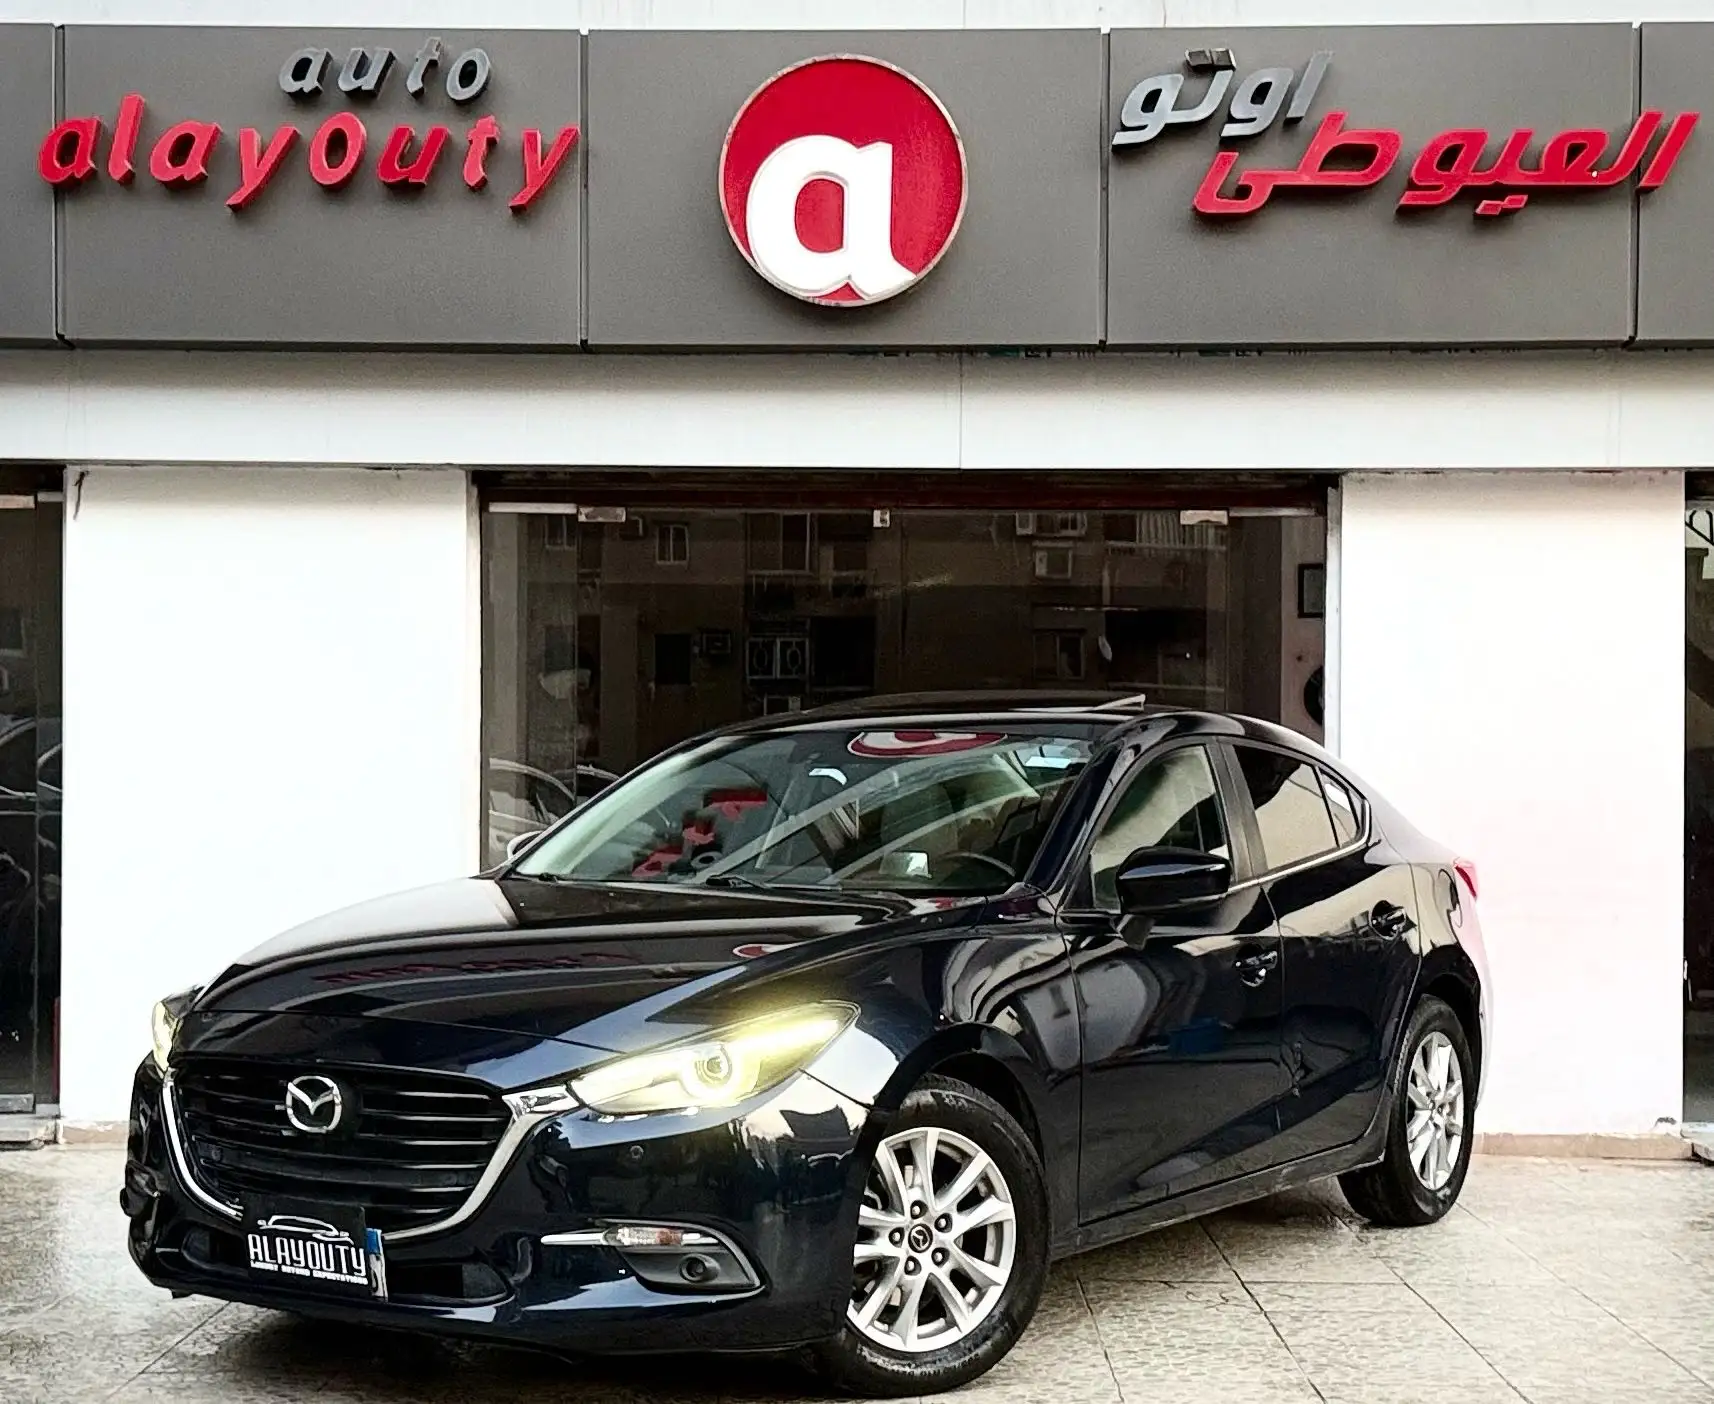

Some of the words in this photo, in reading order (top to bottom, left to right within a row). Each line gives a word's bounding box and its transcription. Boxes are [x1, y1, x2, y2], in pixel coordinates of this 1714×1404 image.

[279, 37, 492, 102] auto
[746, 134, 917, 300] a
[247, 1233, 367, 1277] ALAYOUTY
